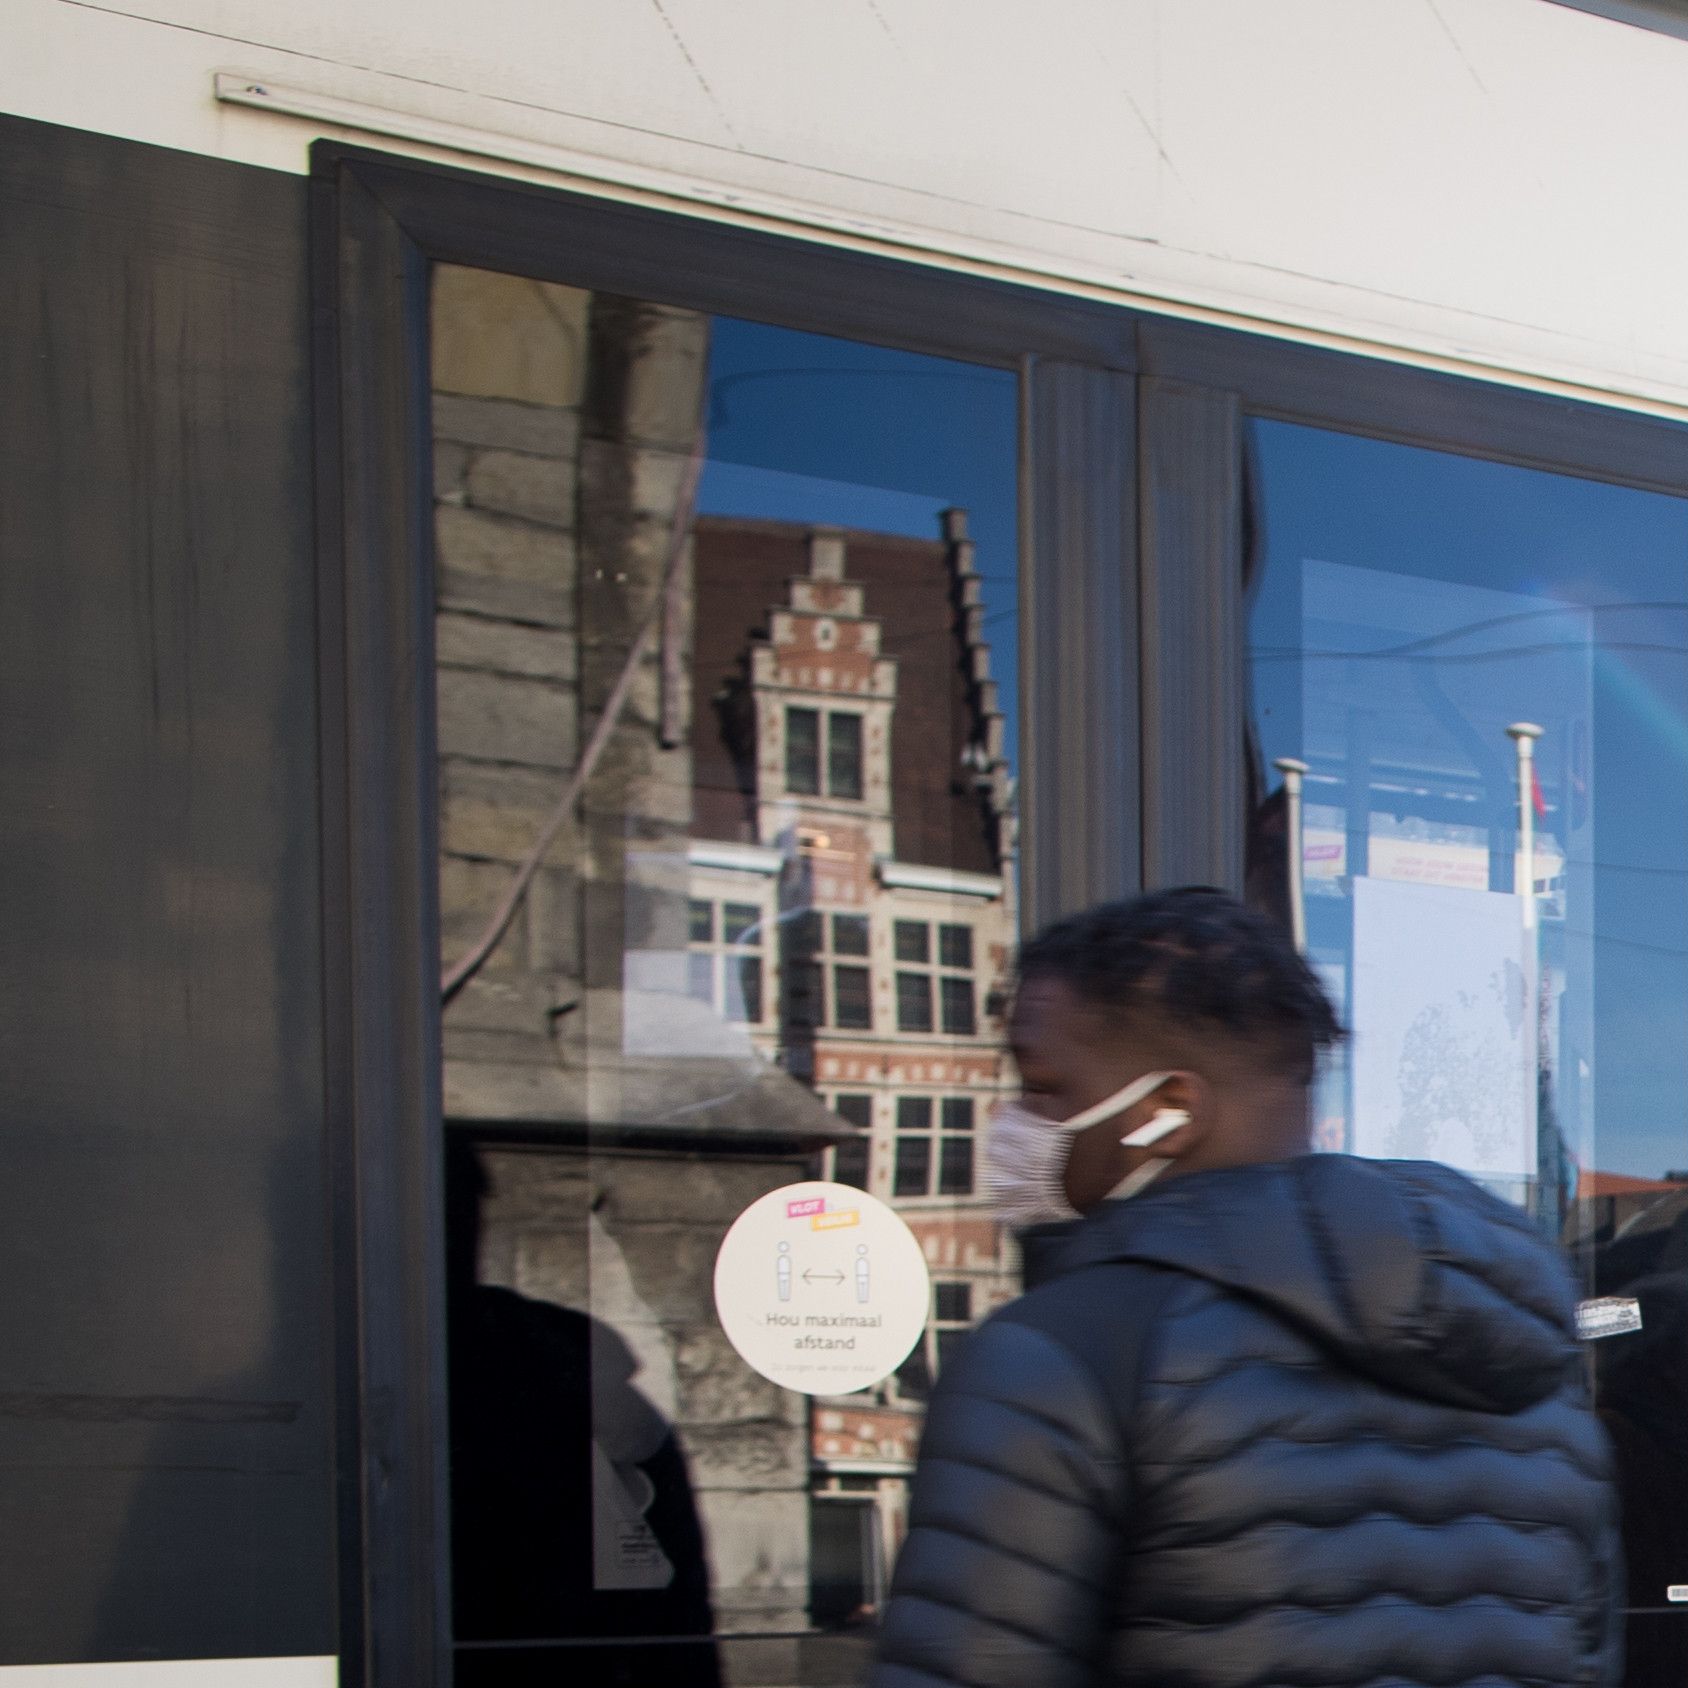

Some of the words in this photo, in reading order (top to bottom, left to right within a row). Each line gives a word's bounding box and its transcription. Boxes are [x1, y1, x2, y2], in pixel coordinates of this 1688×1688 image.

[766, 1312, 800, 1327] Hou
[805, 1313, 883, 1328] maximaal
[794, 1334, 856, 1350] afstand
